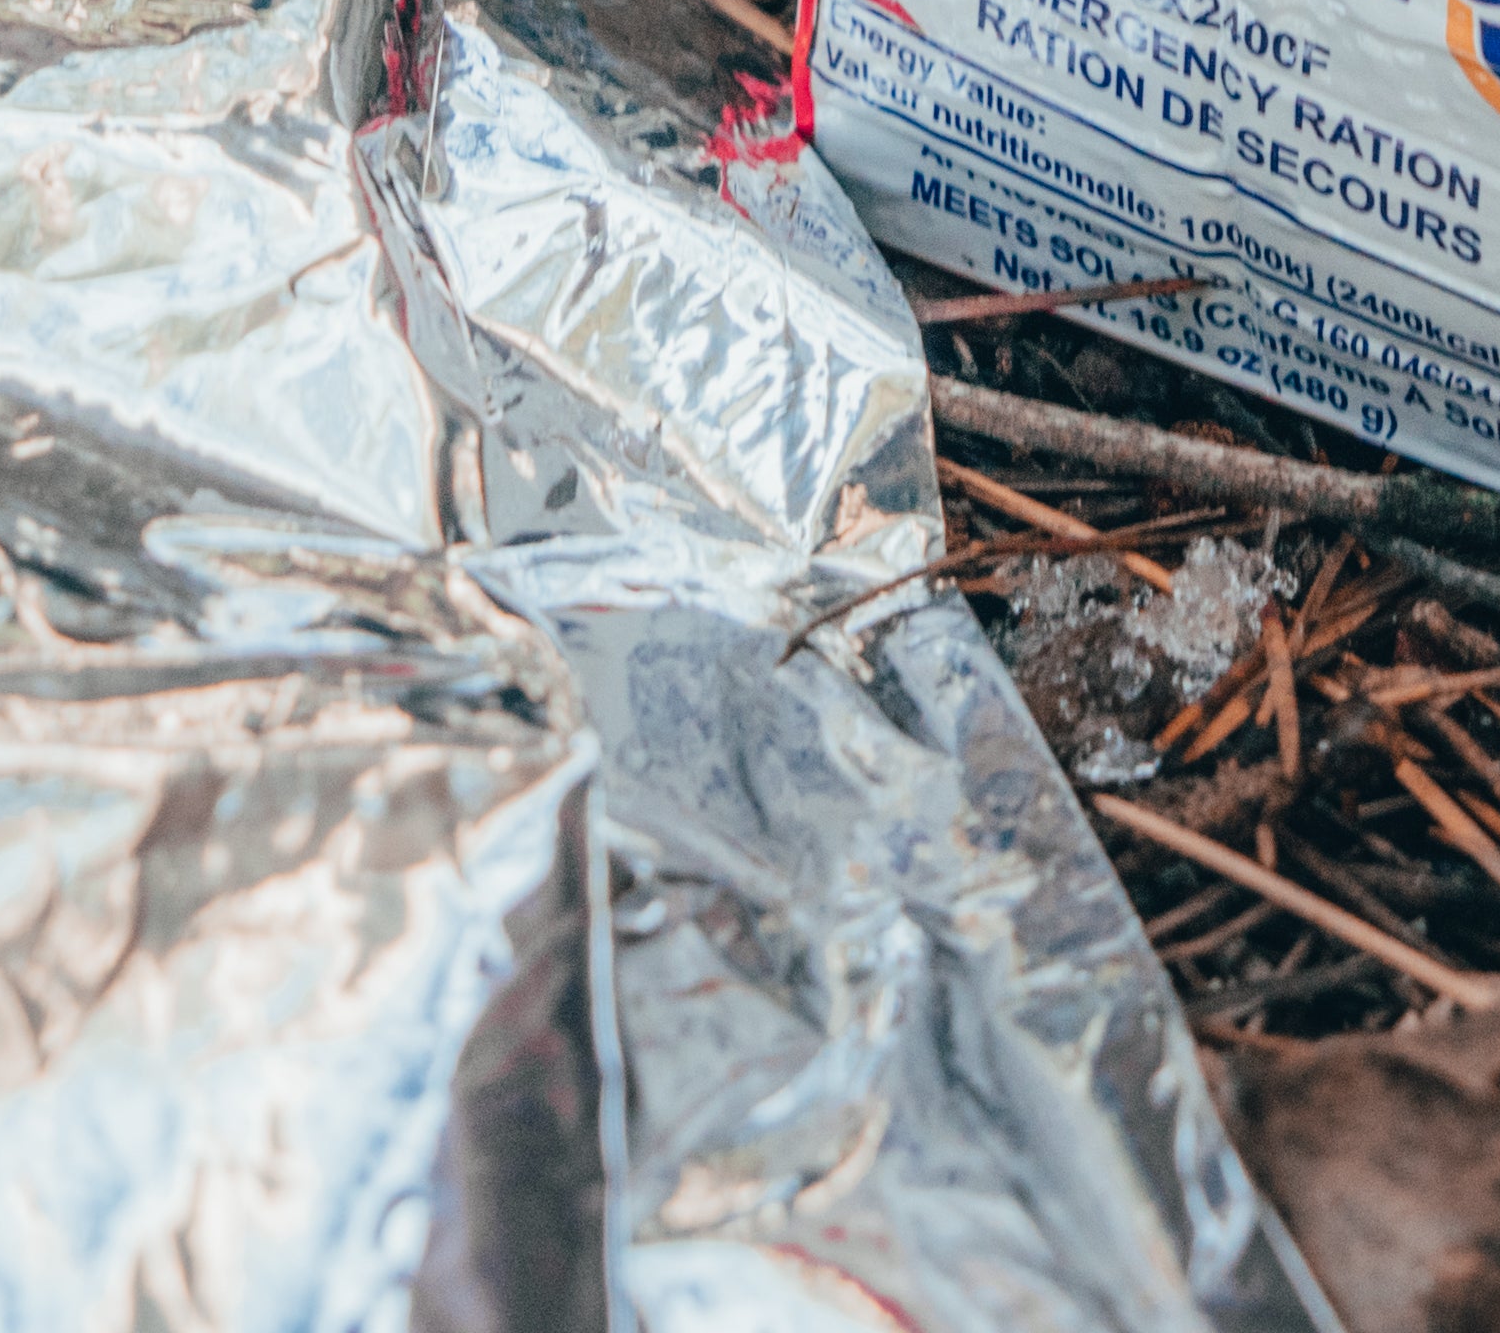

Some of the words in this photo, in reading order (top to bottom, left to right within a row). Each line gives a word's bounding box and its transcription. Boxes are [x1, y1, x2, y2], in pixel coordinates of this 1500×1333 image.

[831, 0, 934, 83] Energy
[946, 62, 1046, 135] Value:
[933, 101, 1167, 230] nutritionnelle:
[1162, 87, 1224, 142] DE
[1237, 129, 1482, 264] SECOURS
[1295, 94, 1481, 211] RATION
[911, 170, 1038, 249] MEETS
[1050, 234, 1179, 312] SOLS
[994, 247, 1052, 292] Net
[1217, 345, 1262, 376] oz
